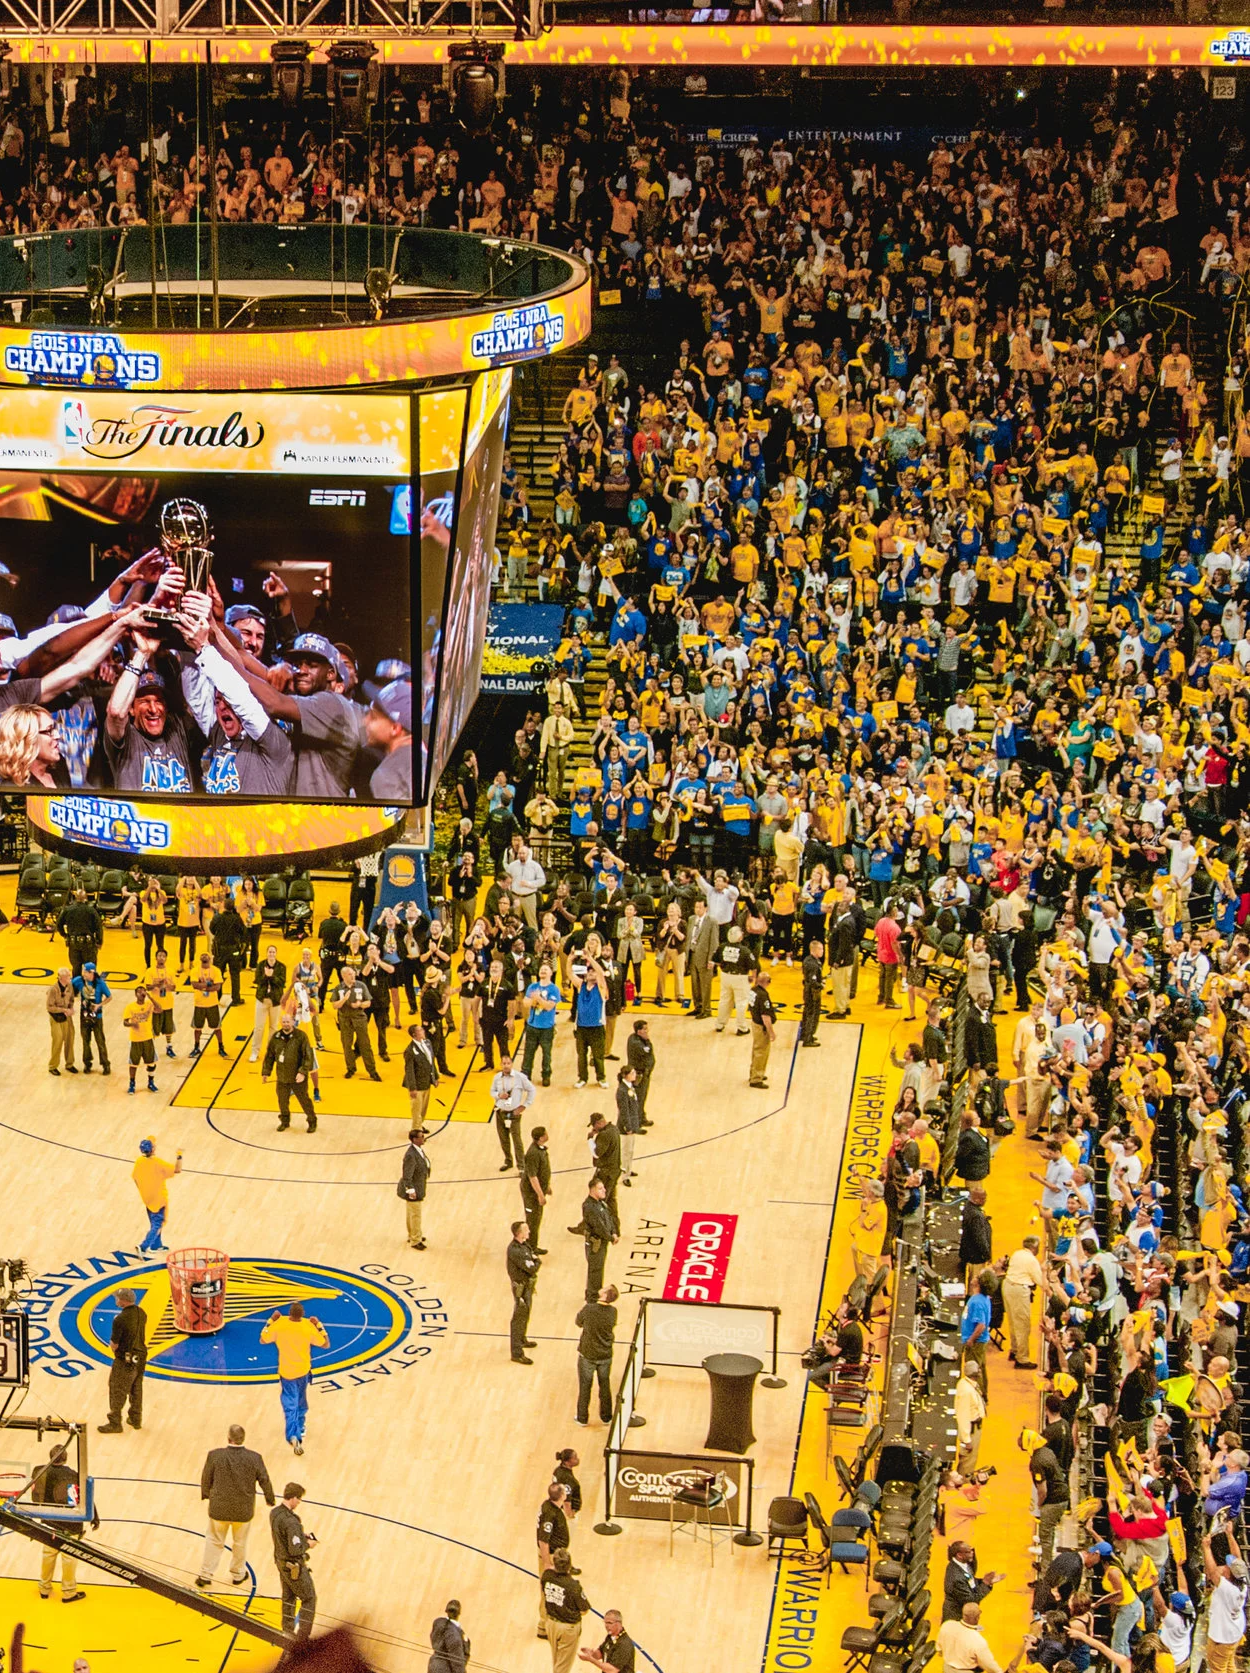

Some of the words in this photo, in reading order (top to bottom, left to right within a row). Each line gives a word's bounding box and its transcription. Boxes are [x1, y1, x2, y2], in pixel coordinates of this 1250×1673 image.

[1211, 41, 1250, 55] CHAM
[1215, 86, 1234, 96] 123
[472, 316, 563, 356] CHAMPIONS
[495, 312, 520, 331] 2015
[525, 306, 547, 325] NBA
[32, 335, 68, 351] 2015
[79, 337, 119, 354] NBA
[6, 348, 157, 381] CHAMPIONS
[86, 419, 139, 445] The
[131, 405, 265, 450] Finals
[309, 489, 367, 506] ESPN
[486, 635, 549, 645] TIONAL
[50, 803, 167, 847] CHAMPIONS
[99, 801, 133, 820] NBA
[620, 1218, 668, 1295] ARENA
[676, 1221, 725, 1301] ORACLE
[359, 1263, 449, 1338] GOLDEN
[310, 1344, 432, 1394] STATE
[774, 1550, 824, 1673] @WARRIO
